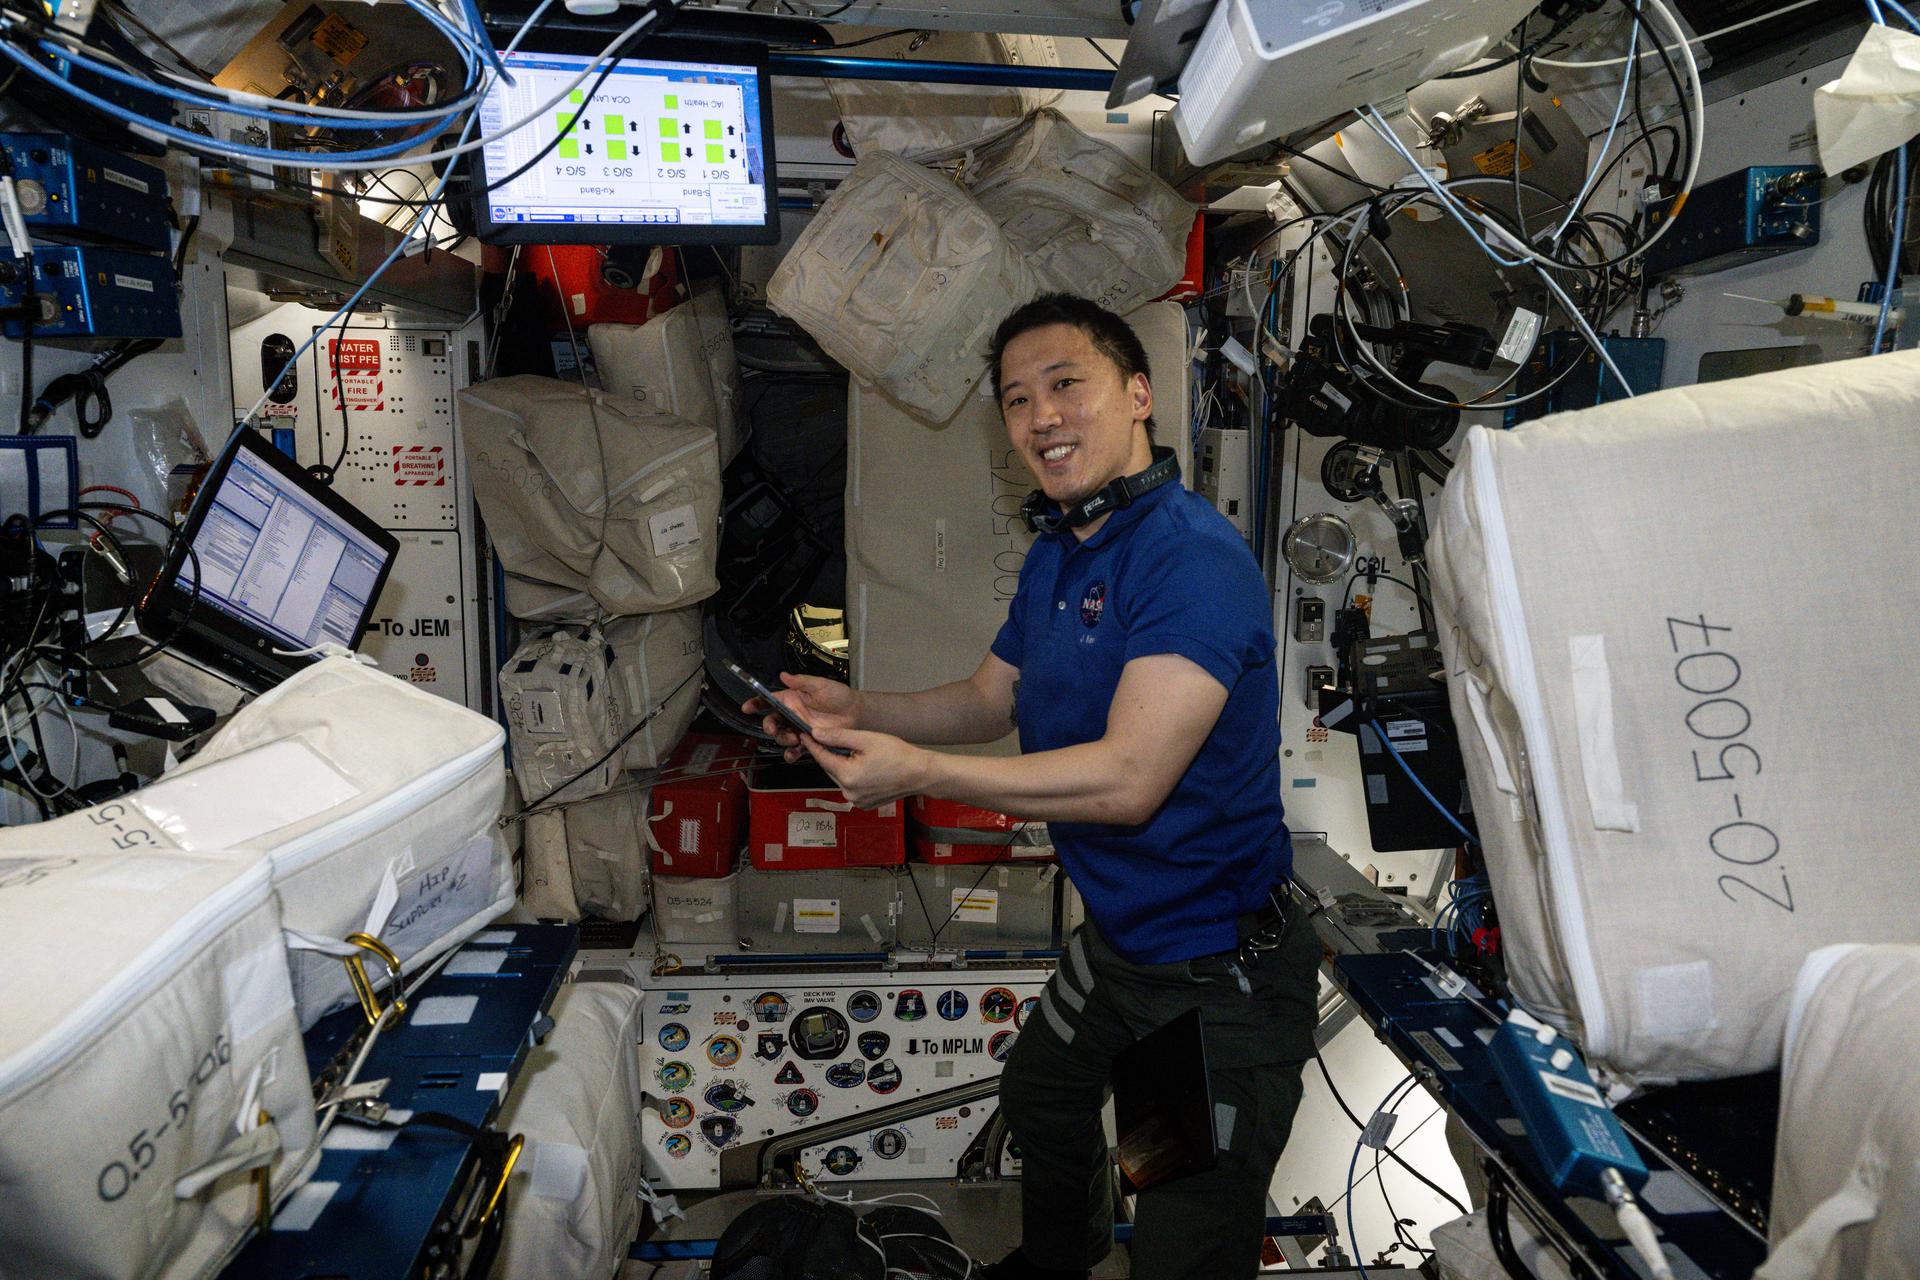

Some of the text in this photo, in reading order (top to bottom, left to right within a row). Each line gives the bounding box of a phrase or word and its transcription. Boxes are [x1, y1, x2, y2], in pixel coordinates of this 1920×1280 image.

[610, 95, 631, 104] OCA
[566, 166, 586, 177] S/G
[612, 167, 633, 178] S/G
[666, 168, 686, 179] S/G
[711, 169, 730, 180] S/G
[580, 186, 615, 196] Ku-Band
[359, 356, 379, 365] PFE
[1308, 394, 1329, 411] Canon
[1082, 496, 1105, 518] PETZL
[1355, 556, 1391, 574] COL
[380, 618, 450, 637] To JEM
[1666, 613, 1796, 914] 2.0-5007
[418, 866, 450, 898] HIP
[922, 1038, 983, 1055] To MPLM
